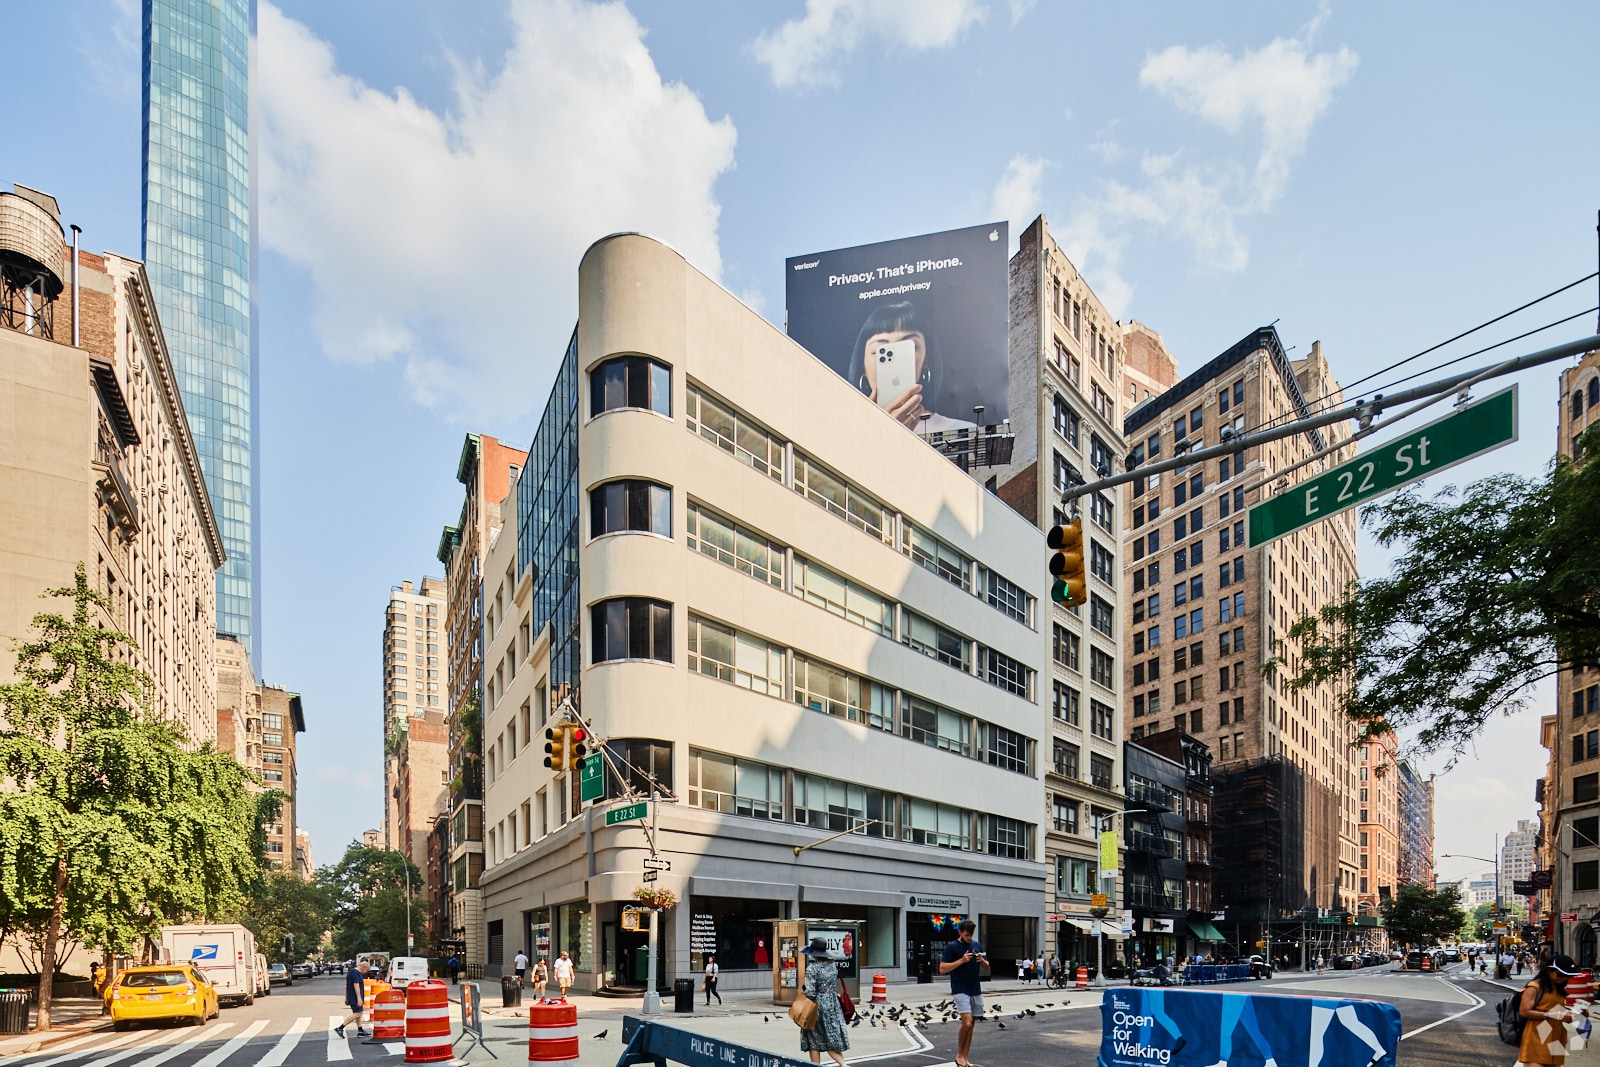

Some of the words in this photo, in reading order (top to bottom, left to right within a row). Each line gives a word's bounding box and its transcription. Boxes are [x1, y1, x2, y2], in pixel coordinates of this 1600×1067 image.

[794, 261, 819, 270] verizon
[829, 272, 875, 287] Privacy.
[876, 263, 914, 279] That's
[916, 257, 962, 273] iPhone.
[858, 281, 931, 299] apple.com/privacy
[1305, 485, 1319, 516] E
[1337, 461, 1375, 502] 22
[1394, 436, 1431, 477] St
[614, 811, 619, 821] E
[620, 809, 627, 820] 22
[629, 807, 636, 818] St
[1113, 1011, 1154, 1029] Open
[1112, 1026, 1132, 1041] for
[691, 1038, 715, 1057] POLICE
[720, 1046, 736, 1064] LINE
[1113, 1041, 1171, 1064] Walking
